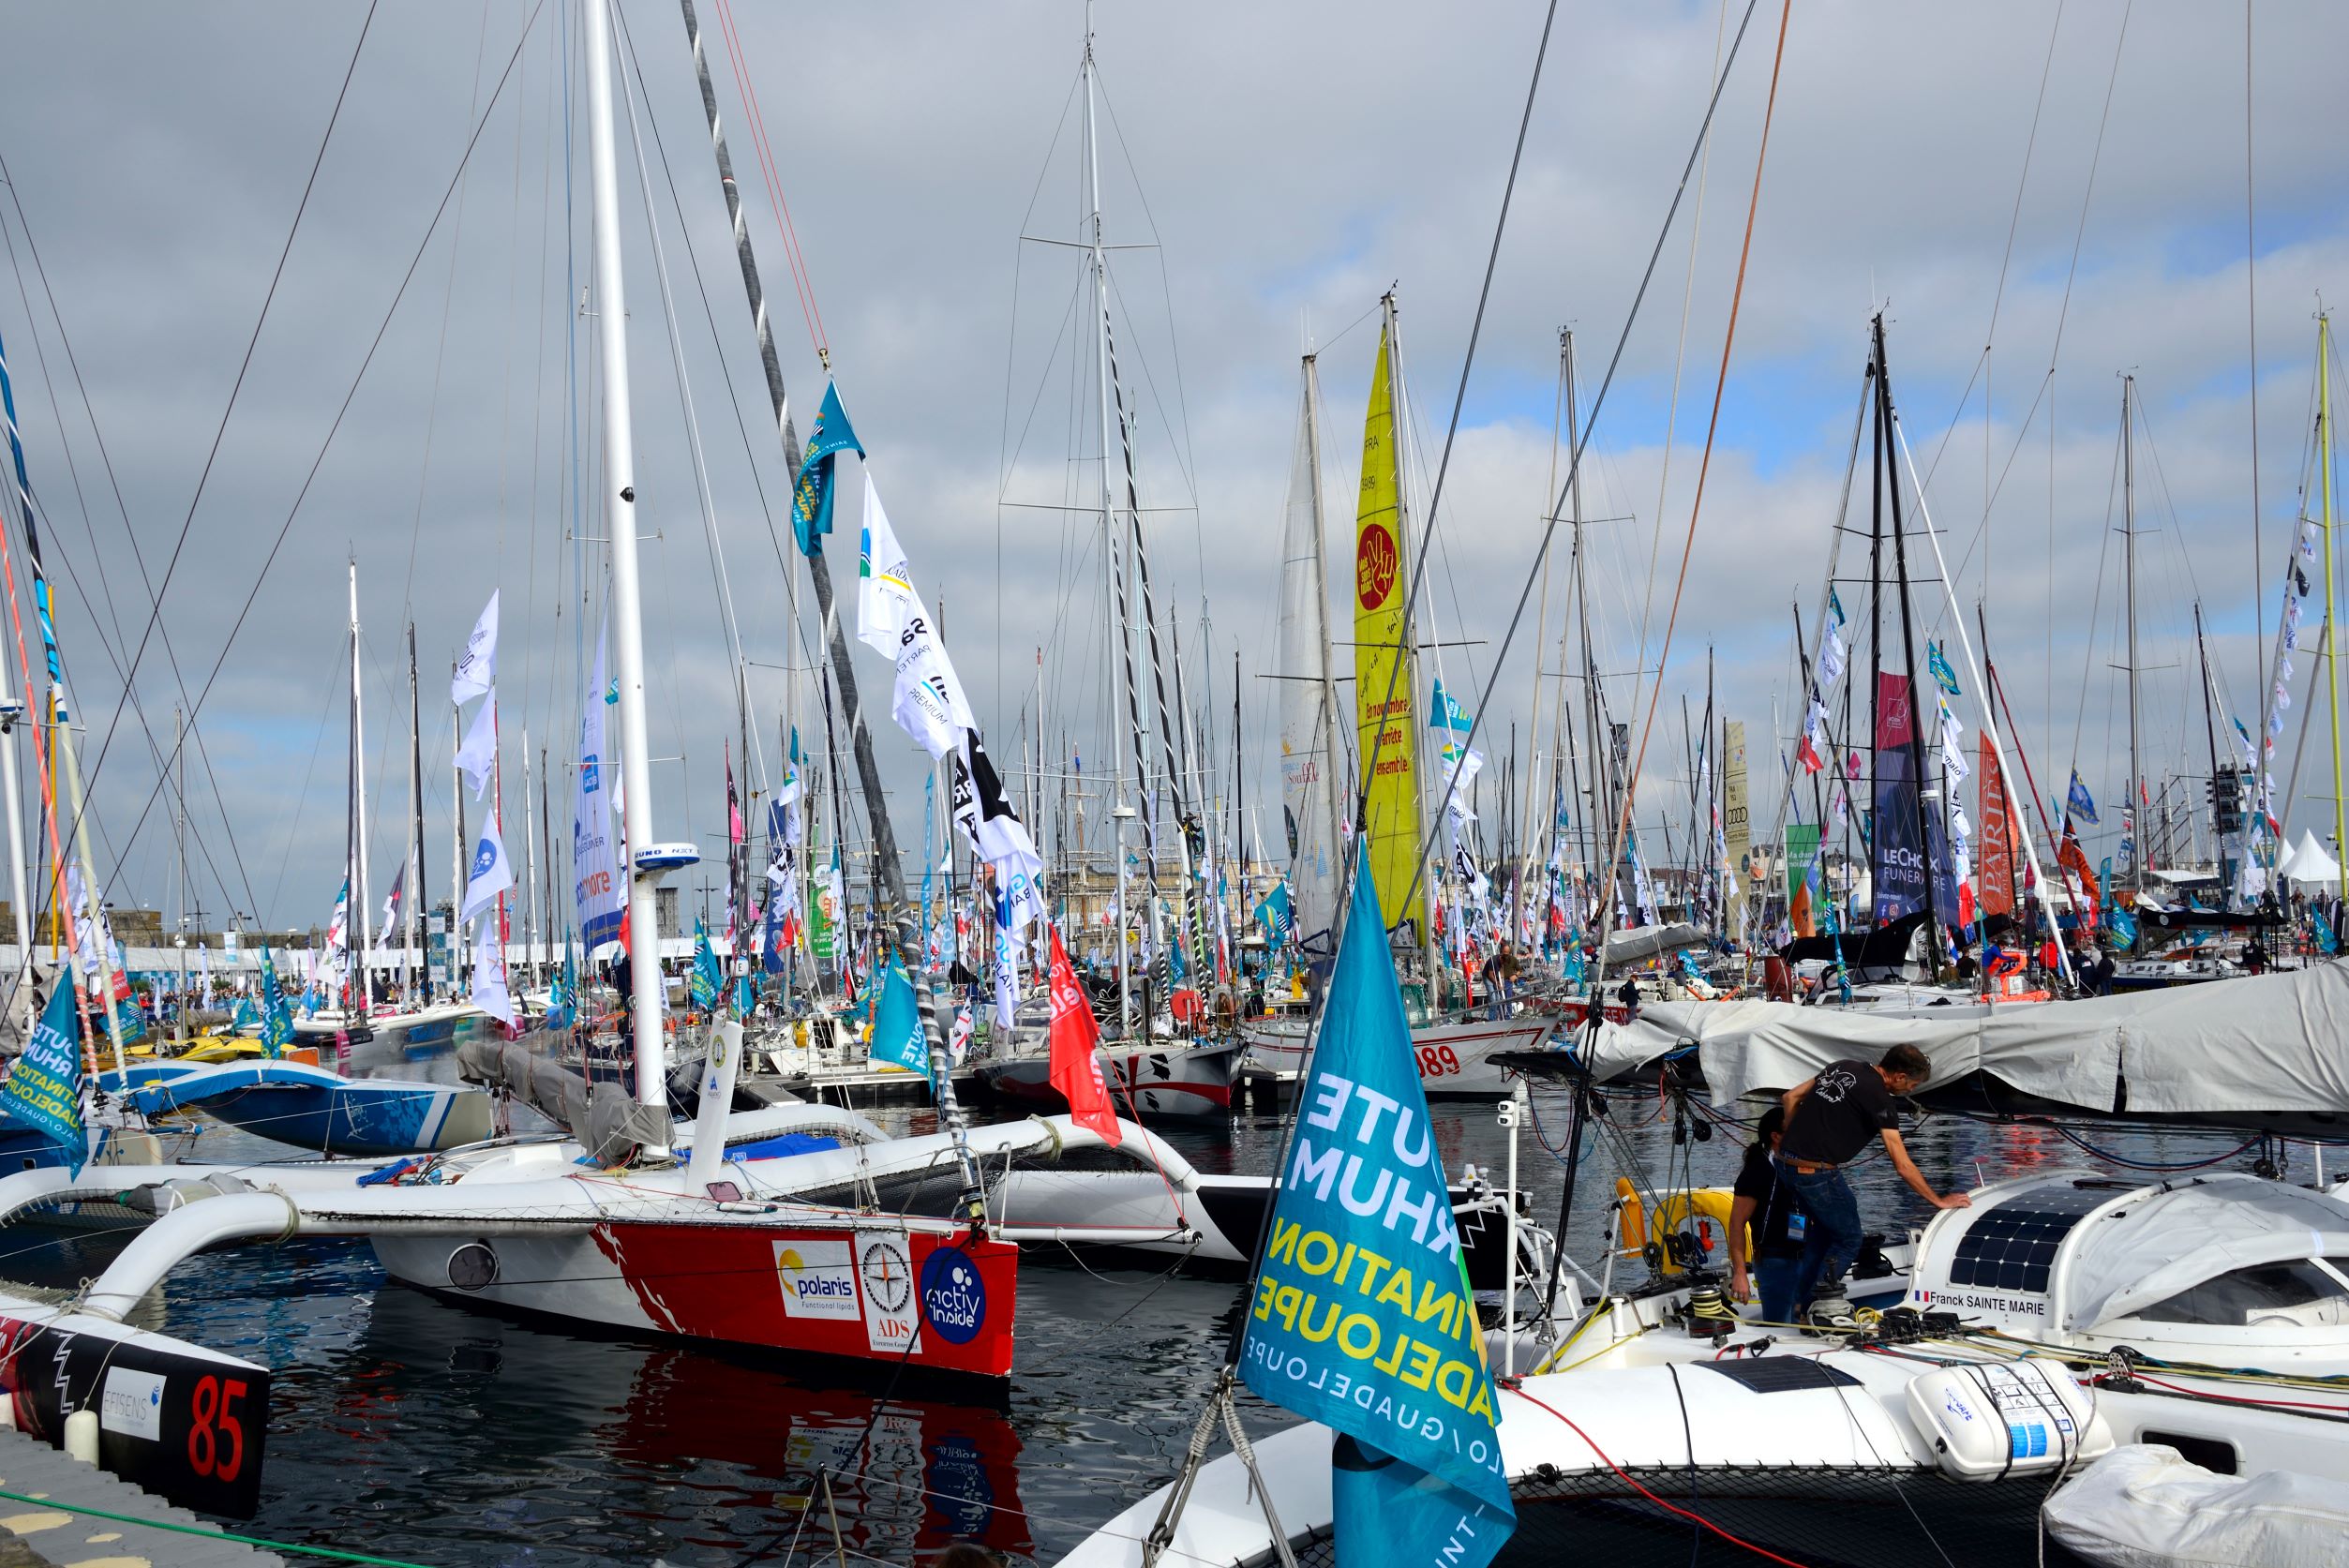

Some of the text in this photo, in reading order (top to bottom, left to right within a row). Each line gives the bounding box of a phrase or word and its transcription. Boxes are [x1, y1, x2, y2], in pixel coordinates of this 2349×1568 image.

[908, 687, 949, 724] PREMIUM
[1944, 754, 1962, 776] malo
[798, 1276, 853, 1300] polaris
[801, 1301, 855, 1311] Functional lipids
[926, 1284, 980, 1317] activ
[1930, 1292, 2044, 1316] Franck SAINTE MARIE
[876, 1319, 910, 1338] ADS
[932, 1306, 976, 1328] inside
[103, 1390, 147, 1422] EFISENS
[188, 1375, 247, 1483] 85
